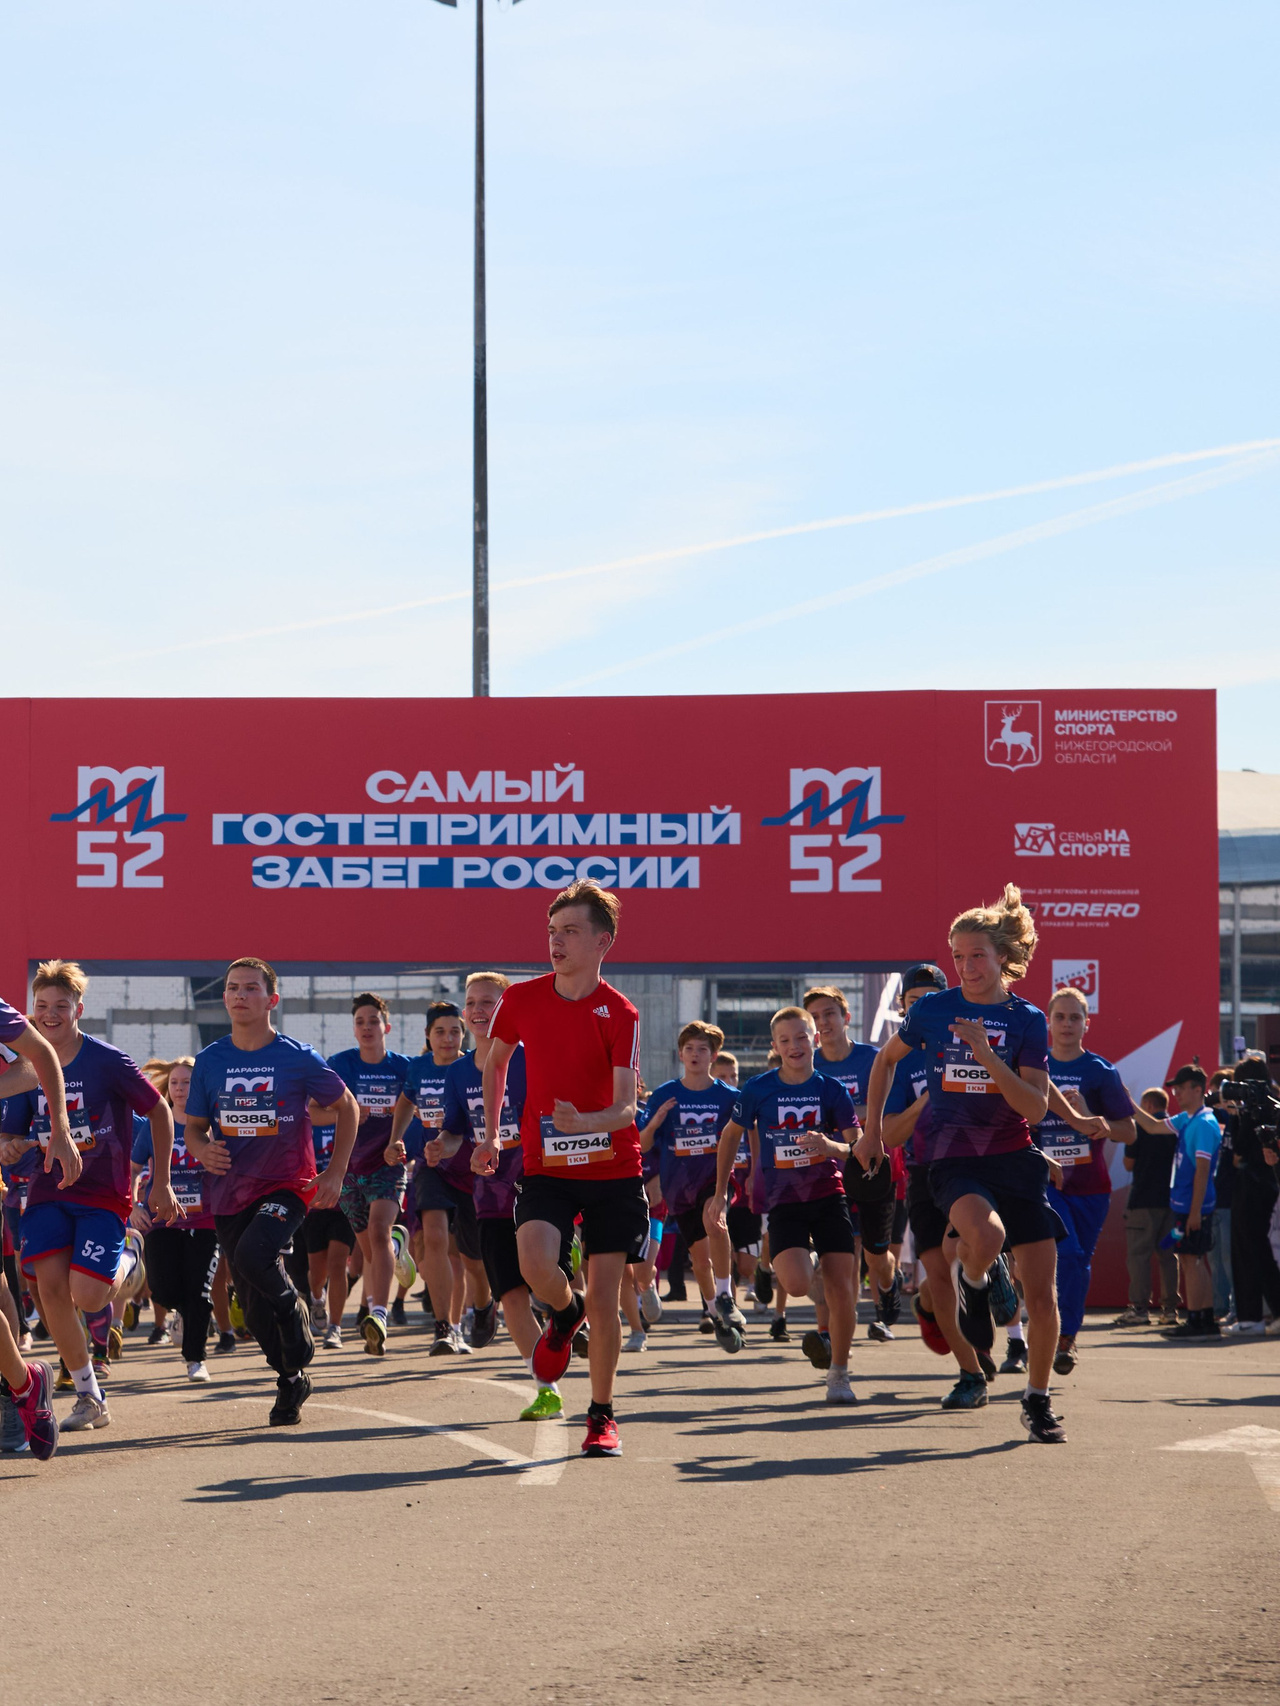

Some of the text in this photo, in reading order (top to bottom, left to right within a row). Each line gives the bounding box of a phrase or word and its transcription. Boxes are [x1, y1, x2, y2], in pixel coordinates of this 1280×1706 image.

[1054, 710, 1178, 722] МИНИСТЕРСТВО
[1054, 723, 1116, 736] СПОРТА
[1054, 738, 1173, 752] НИЖЕГОРОДСКОЙ
[1054, 753, 1117, 764] ОБЛАСТИ
[365, 763, 584, 803] САМЫЙ
[212, 805, 740, 846] ГОСТЕПРИИМНЫЙ
[1058, 828, 1130, 843] СЕМЬЯ НА
[1058, 842, 1131, 857] СПОРТЕ
[77, 831, 164, 888] 52
[789, 836, 881, 892] 52
[252, 855, 699, 888] ЗАБЕГ РОССИИ
[1040, 902, 1141, 918] TORERO
[952, 1068, 991, 1080] 1065
[225, 1115, 270, 1124] 10388
[423, 1110, 442, 1118] 110
[552, 1137, 600, 1151] 10794
[682, 1138, 710, 1147] 11044
[1052, 1147, 1081, 1157] 11103
[81, 1239, 106, 1263] 52
